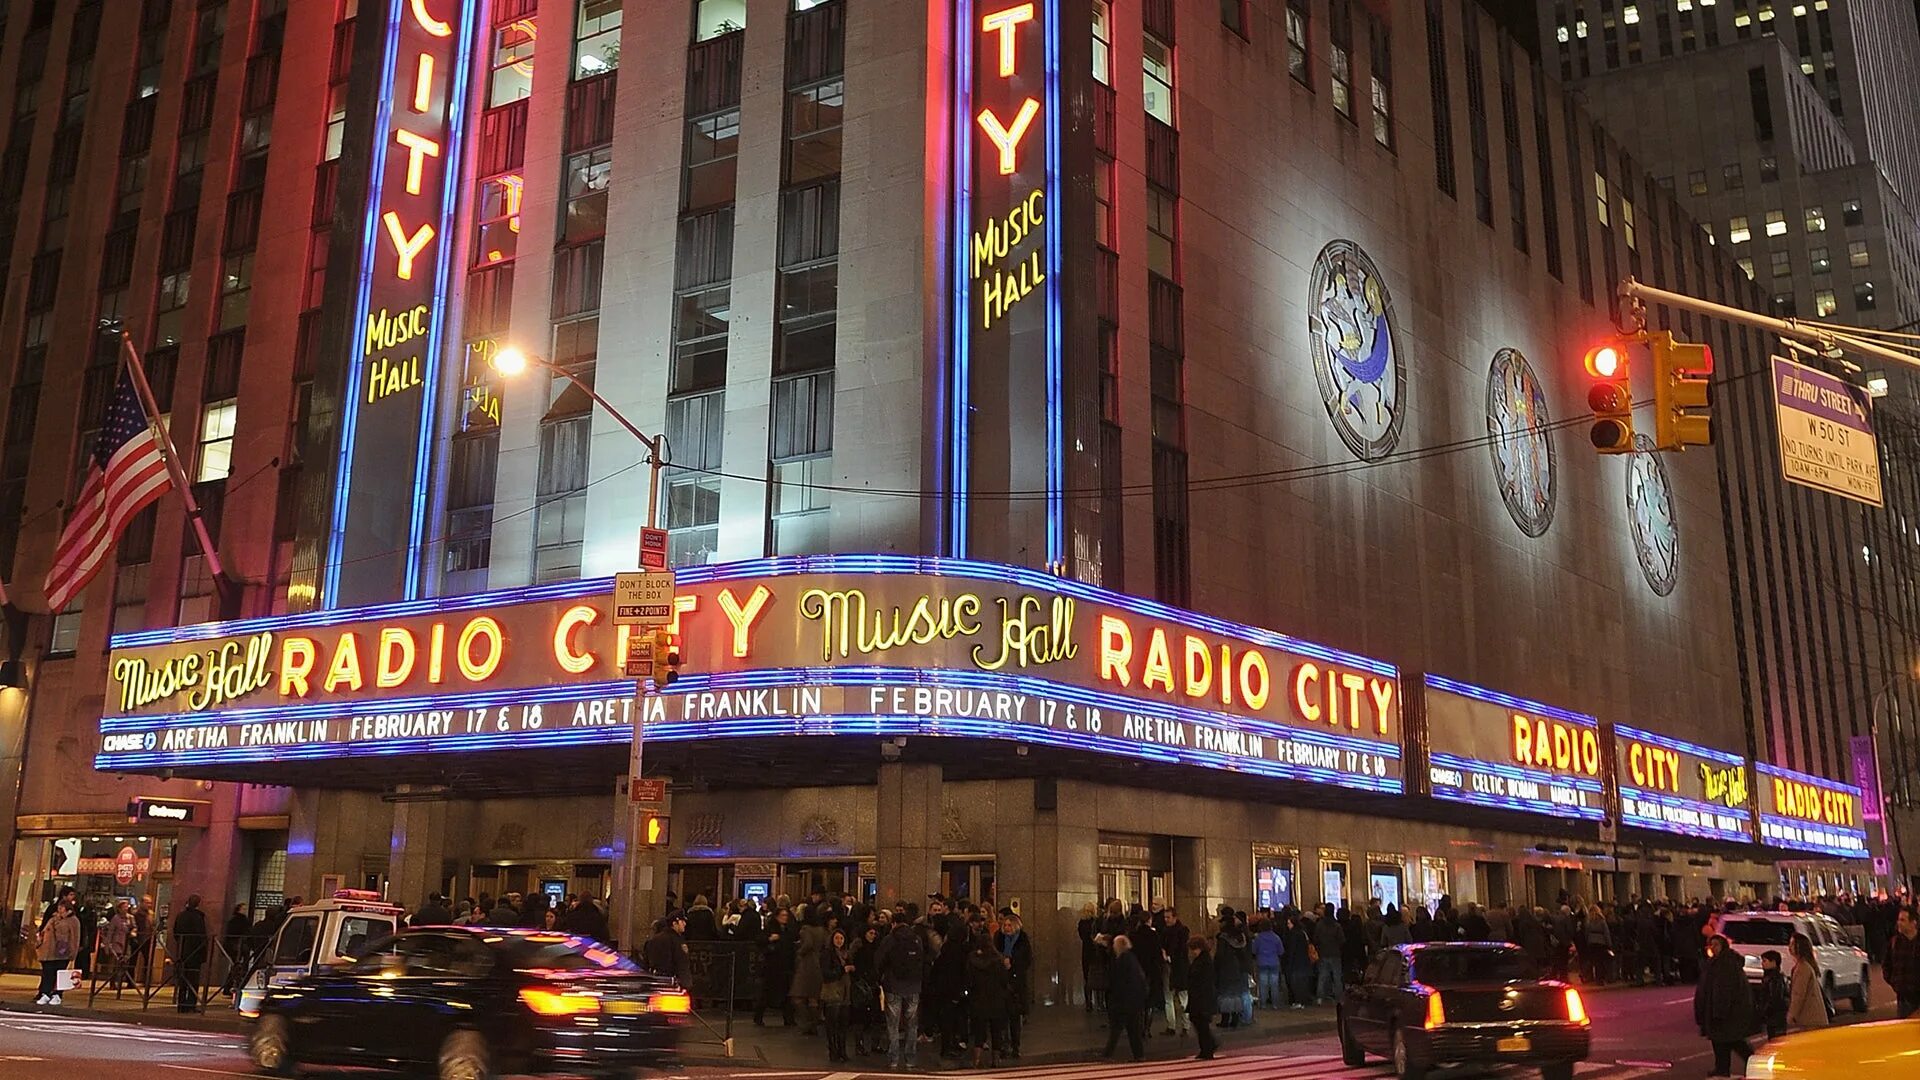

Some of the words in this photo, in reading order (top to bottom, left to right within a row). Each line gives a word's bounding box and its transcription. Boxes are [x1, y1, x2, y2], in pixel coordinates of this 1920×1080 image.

[974, 189, 1044, 279] MUSIC
[983, 251, 1046, 329] HALL
[365, 305, 428, 356] MUSIC
[367, 356, 423, 404] HALL
[1793, 378, 1818, 404] THRU
[1820, 387, 1852, 416] STREET
[1808, 418, 1817, 437] W
[1820, 422, 1835, 442] 50
[1838, 429, 1850, 448] ST
[1784, 438, 1797, 455] NO
[1798, 442, 1824, 463] TURNS
[1825, 449, 1845, 470] UNTIL
[1846, 457, 1864, 475] PARK
[1865, 463, 1877, 480] AVE
[619, 580, 642, 590] DON'T
[645, 579, 671, 589] BLOCK
[628, 591, 642, 600] THE
[646, 590, 662, 600] BOX
[619, 606, 634, 616] FINE
[645, 606, 668, 616] POINTS
[800, 588, 981, 662] Music
[972, 593, 1079, 671] Hall
[114, 653, 199, 712] Music
[188, 630, 273, 711] Hall
[279, 615, 503, 698] RADIO
[1100, 614, 1270, 711] RADIO
[1296, 662, 1392, 735] CITY
[103, 733, 145, 751] CHASE
[162, 726, 228, 751] ARETHA
[239, 719, 328, 746] FRANKLIN
[351, 711, 454, 740] FEBRUARY
[466, 708, 487, 733] 17
[496, 706, 510, 732] &
[522, 703, 543, 730] 18
[684, 687, 821, 720] FRANKLIN
[870, 686, 1026, 723] FEBRUARY
[1039, 697, 1057, 727] 17
[1066, 703, 1077, 730] &
[1086, 708, 1102, 733] 18
[1123, 714, 1186, 746] ARETHA
[1195, 725, 1264, 759] FRANKLIN
[1278, 739, 1340, 771] FEBRUARY
[1346, 750, 1358, 773] 17
[1362, 754, 1371, 775] &
[1375, 756, 1387, 778] 18
[1513, 714, 1599, 776] RADIO
[1629, 742, 1680, 793] CITY
[1472, 772, 1505, 796] CELTIC
[1507, 778, 1540, 800] WOMAN
[1774, 777, 1821, 822] RADIO
[1822, 789, 1854, 827] CITY
